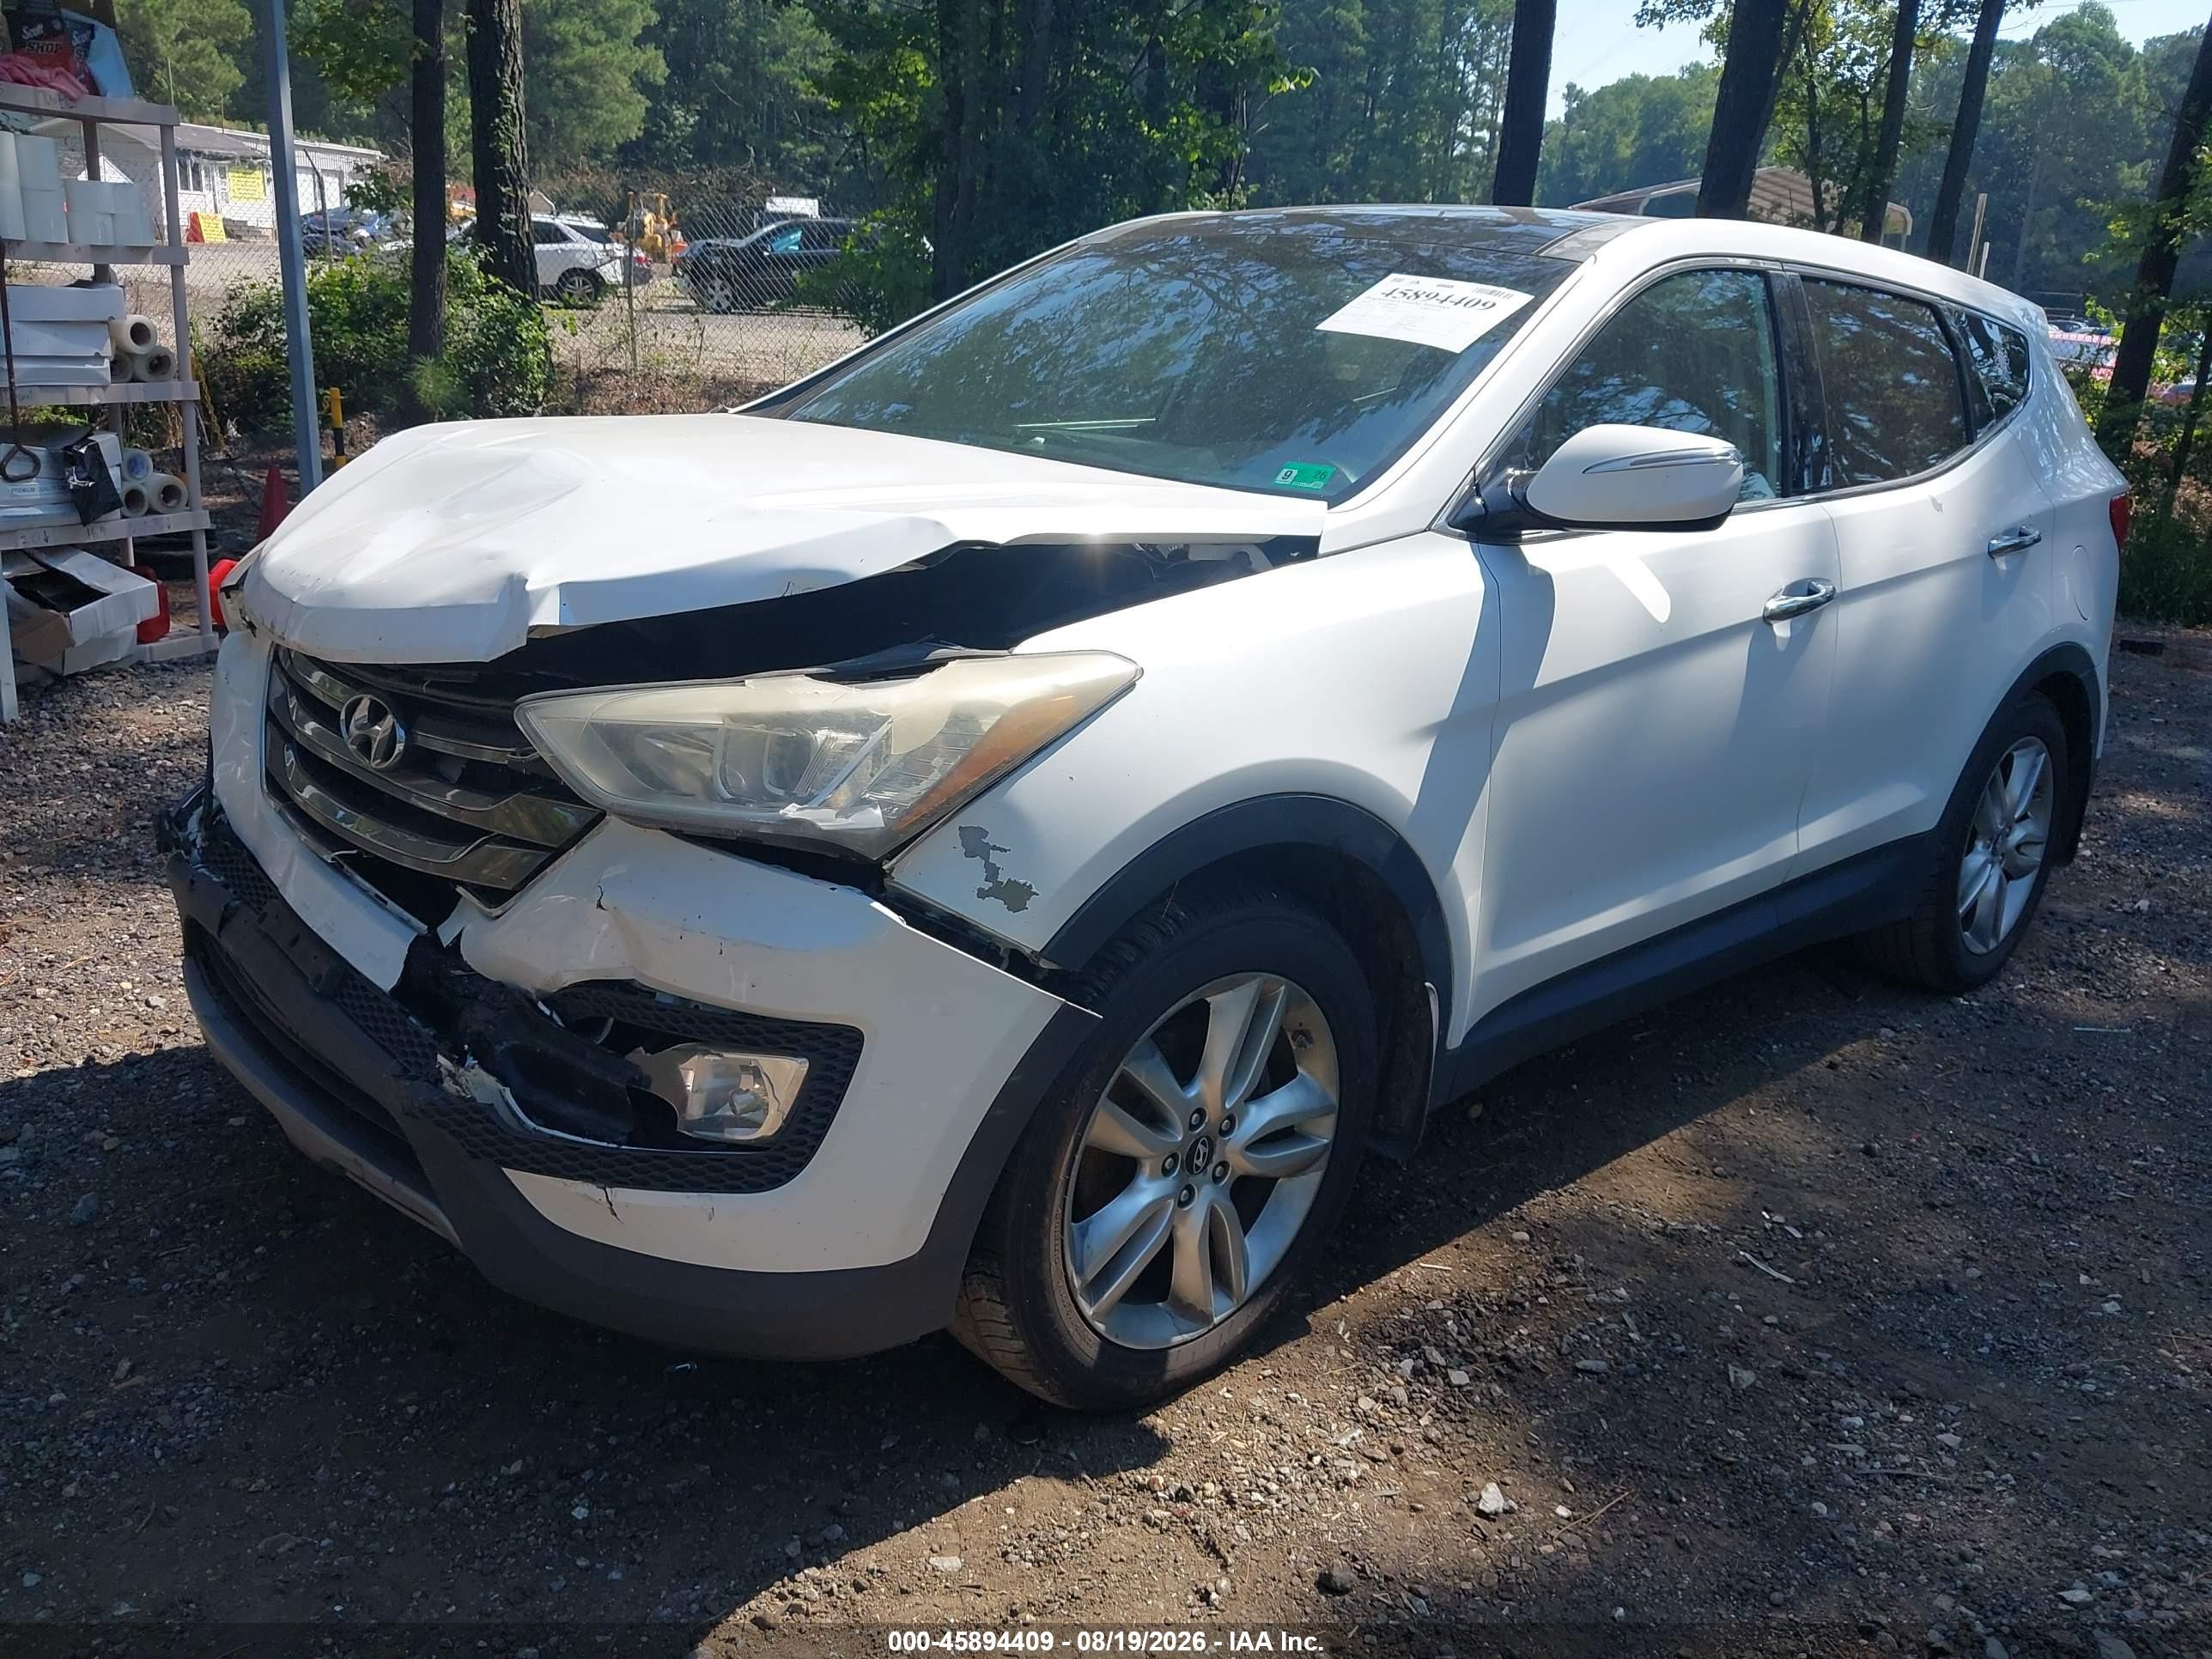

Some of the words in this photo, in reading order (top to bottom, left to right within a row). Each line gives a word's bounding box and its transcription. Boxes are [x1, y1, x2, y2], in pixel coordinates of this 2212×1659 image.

[26, 41, 63, 54] SHOP
[1381, 288, 1497, 311] 45894409
[1281, 470, 1293, 480] 9
